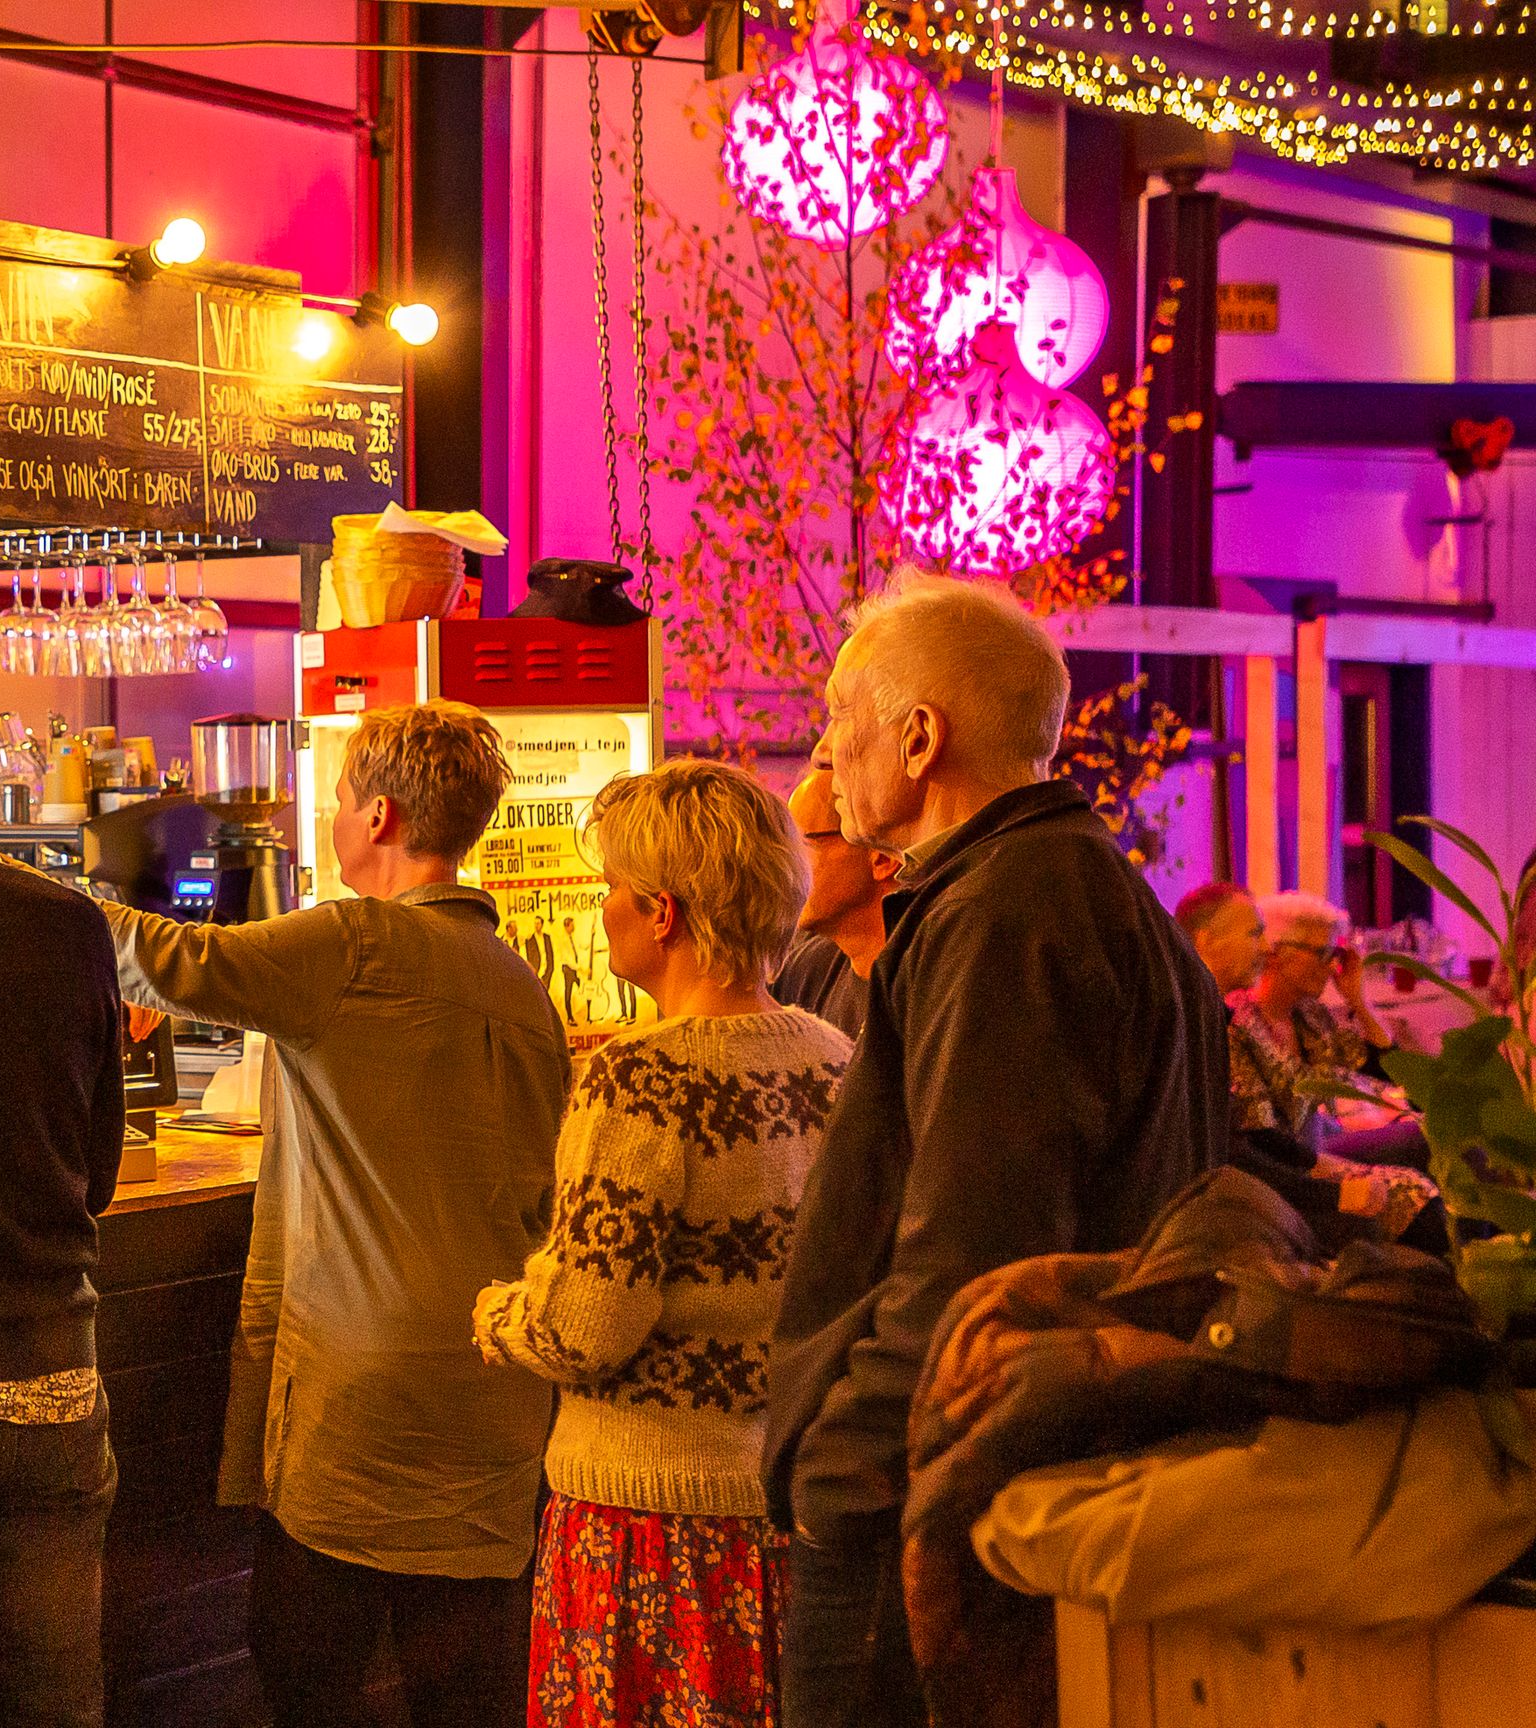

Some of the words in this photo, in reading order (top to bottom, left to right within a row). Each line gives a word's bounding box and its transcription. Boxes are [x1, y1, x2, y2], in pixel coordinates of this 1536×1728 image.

[209, 302, 290, 373] VAN
[19, 455, 56, 501] OGSÅ
[144, 471, 193, 509] BAREN
[211, 449, 280, 484] ØKO-BRUS
[294, 461, 319, 481] FLERE
[323, 463, 348, 482] VAR.
[213, 488, 257, 527] VAND
[512, 772, 567, 787] medjen
[486, 802, 574, 831] 2.OKTOBER
